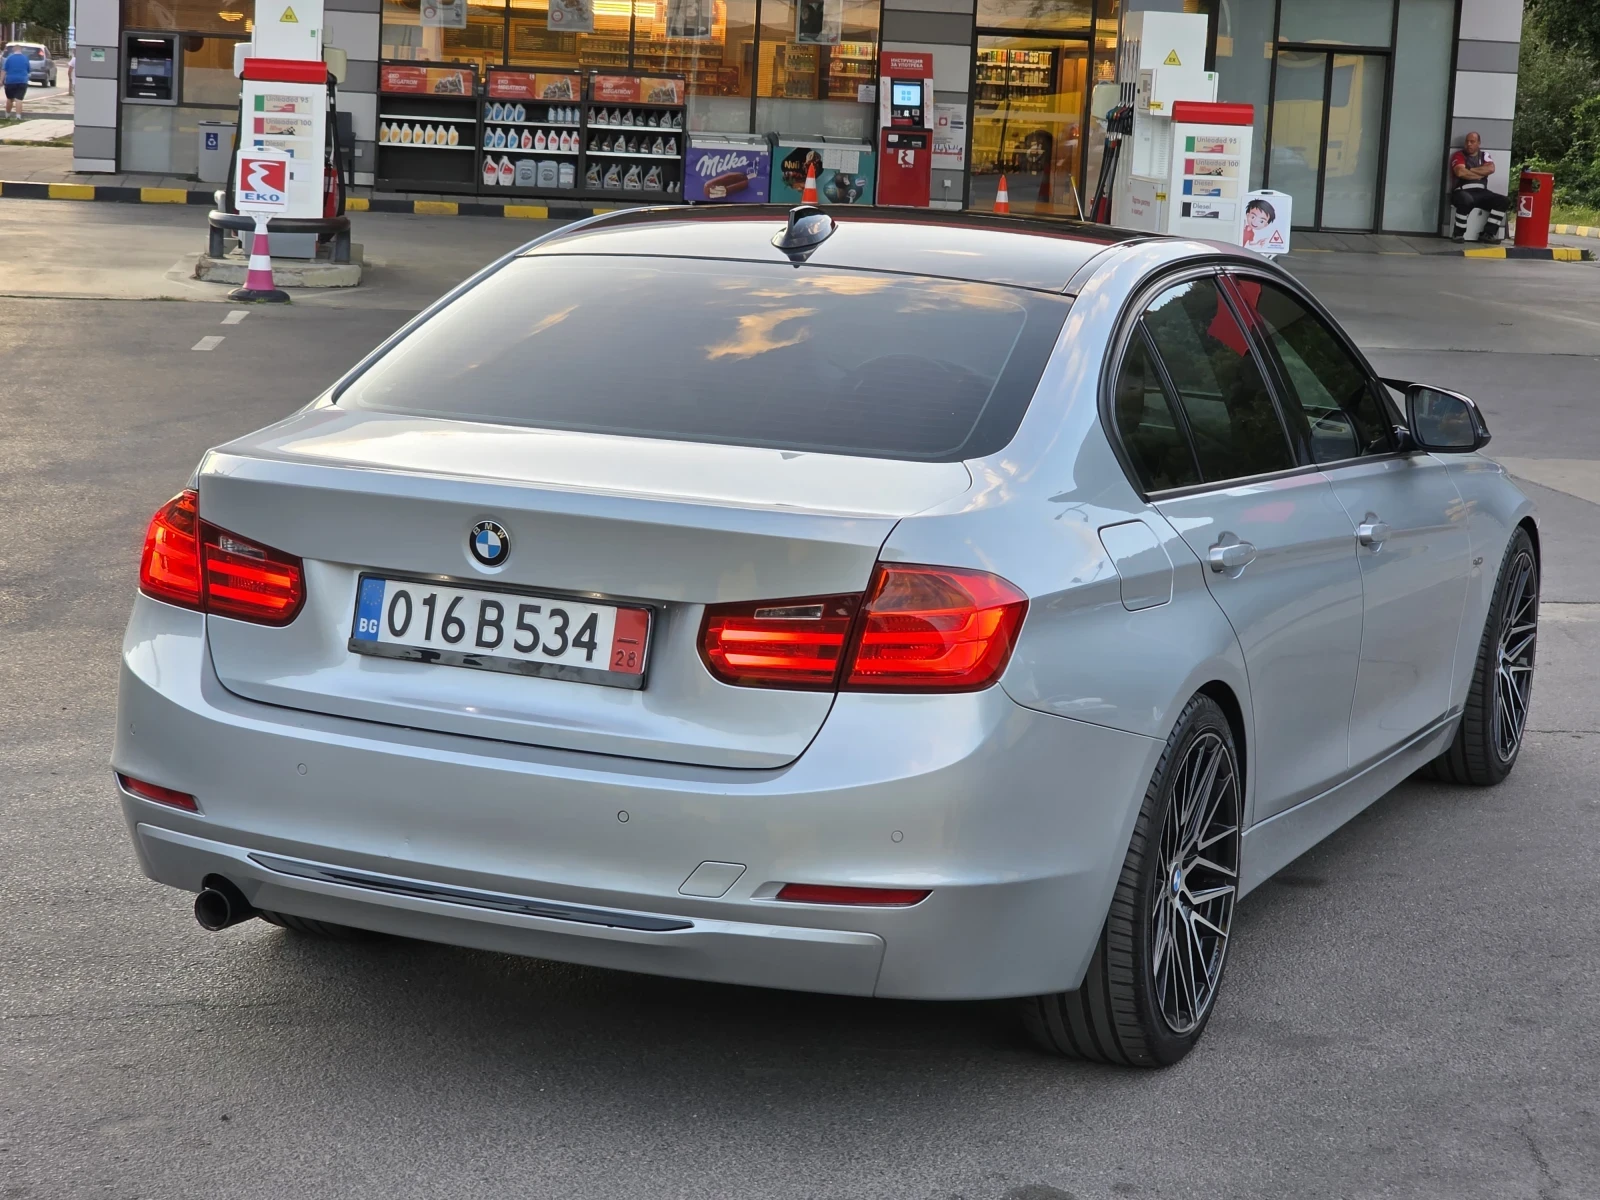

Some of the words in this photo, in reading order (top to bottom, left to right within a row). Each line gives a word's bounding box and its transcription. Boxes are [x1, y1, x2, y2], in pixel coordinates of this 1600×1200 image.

[265, 94, 299, 103] Unleaded
[265, 118, 299, 126] Unleaded
[300, 119, 312, 127] 100
[265, 139, 286, 147] Diesel
[1196, 136, 1228, 144] Unleaded
[696, 152, 750, 177] Milka
[1195, 159, 1227, 167] Unleaded
[244, 192, 281, 202] EKO
[1192, 202, 1212, 210] Diesel
[472, 523, 506, 539] BMW
[359, 617, 378, 634] BG
[387, 589, 599, 662] 016B534
[614, 650, 636, 668] 28
